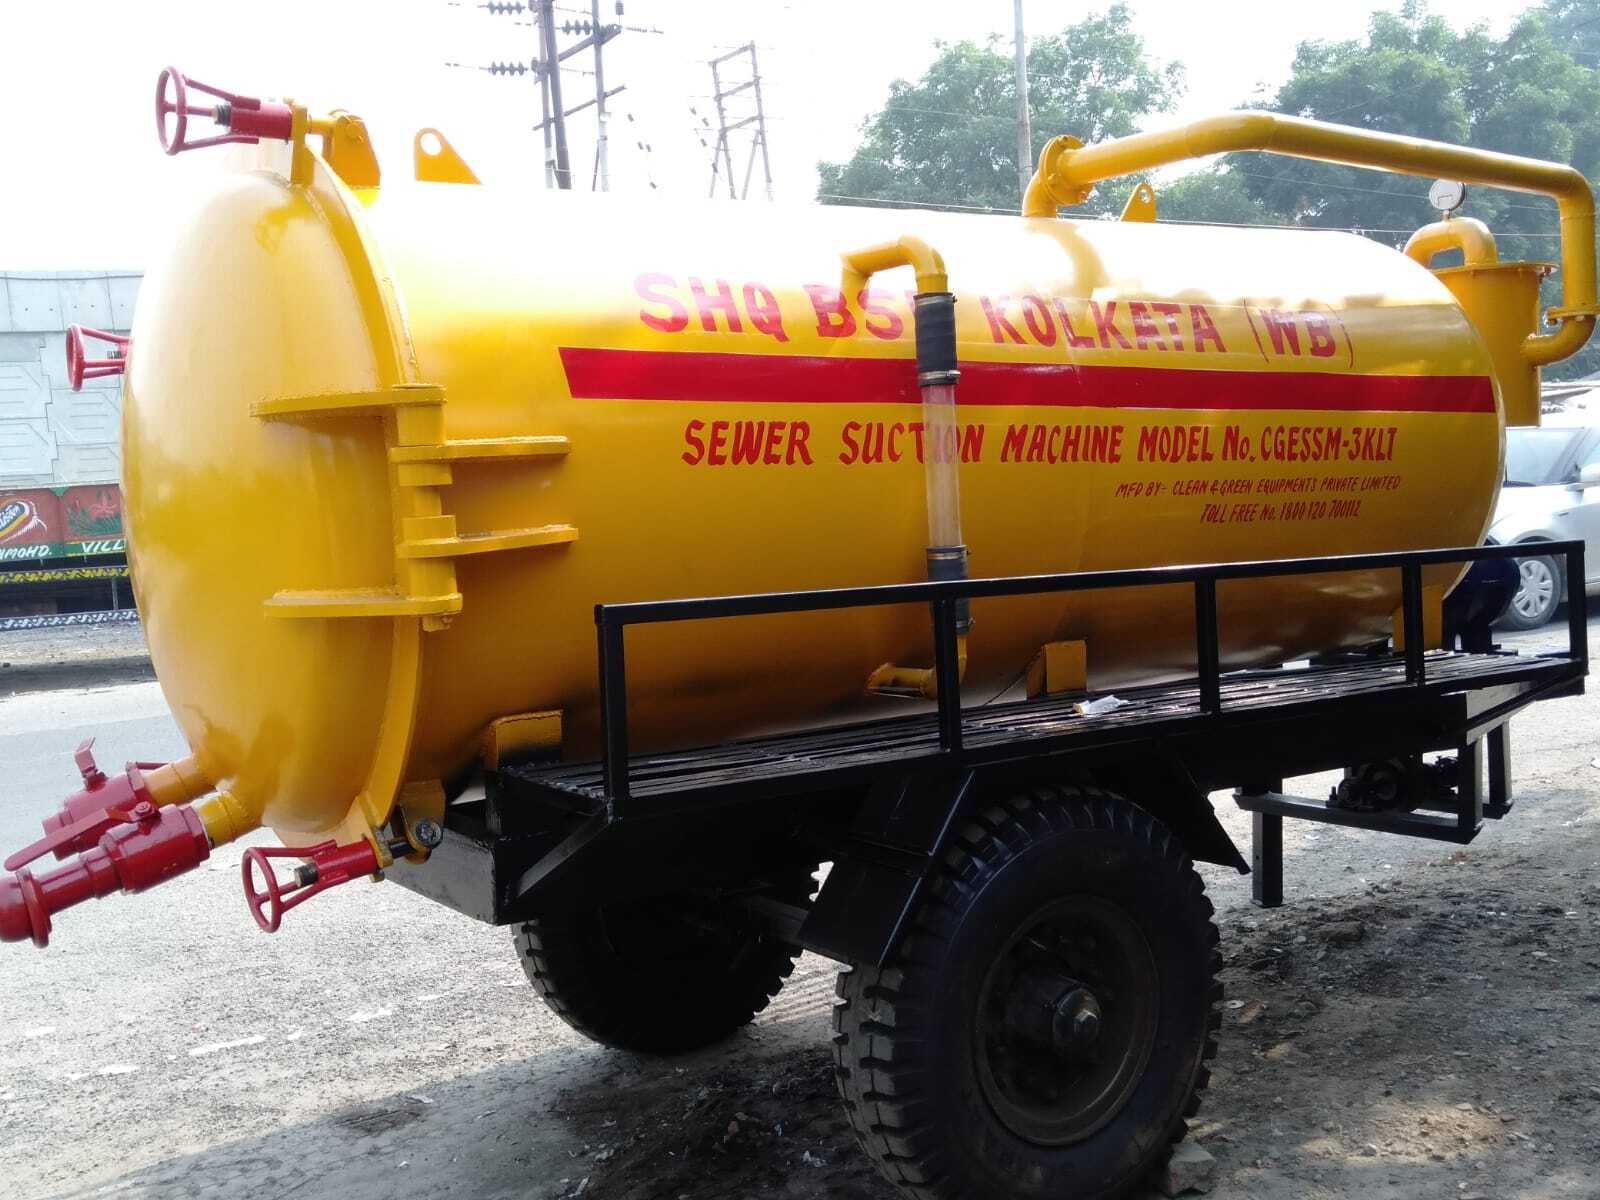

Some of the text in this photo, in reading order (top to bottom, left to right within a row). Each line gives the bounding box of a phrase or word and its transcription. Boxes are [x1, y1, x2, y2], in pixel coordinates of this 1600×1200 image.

[634, 272, 1354, 368] SHQ BS KOLKATA (WB)
[682, 419, 1398, 466] SEWER SUCTION MACHINE MODEL No. CGESSM-3KLT
[1115, 482, 1143, 498] MFD
[1172, 479, 1209, 496] CLEAN
[1256, 477, 1318, 494] EQUIPMENTS
[1320, 476, 1359, 492] PRIVATE
[1360, 475, 1402, 491] LIMITED
[1200, 503, 1229, 524] TOLL
[1230, 502, 1259, 523] FREE
[1279, 500, 1306, 521] 1800
[1307, 500, 1327, 520] 120
